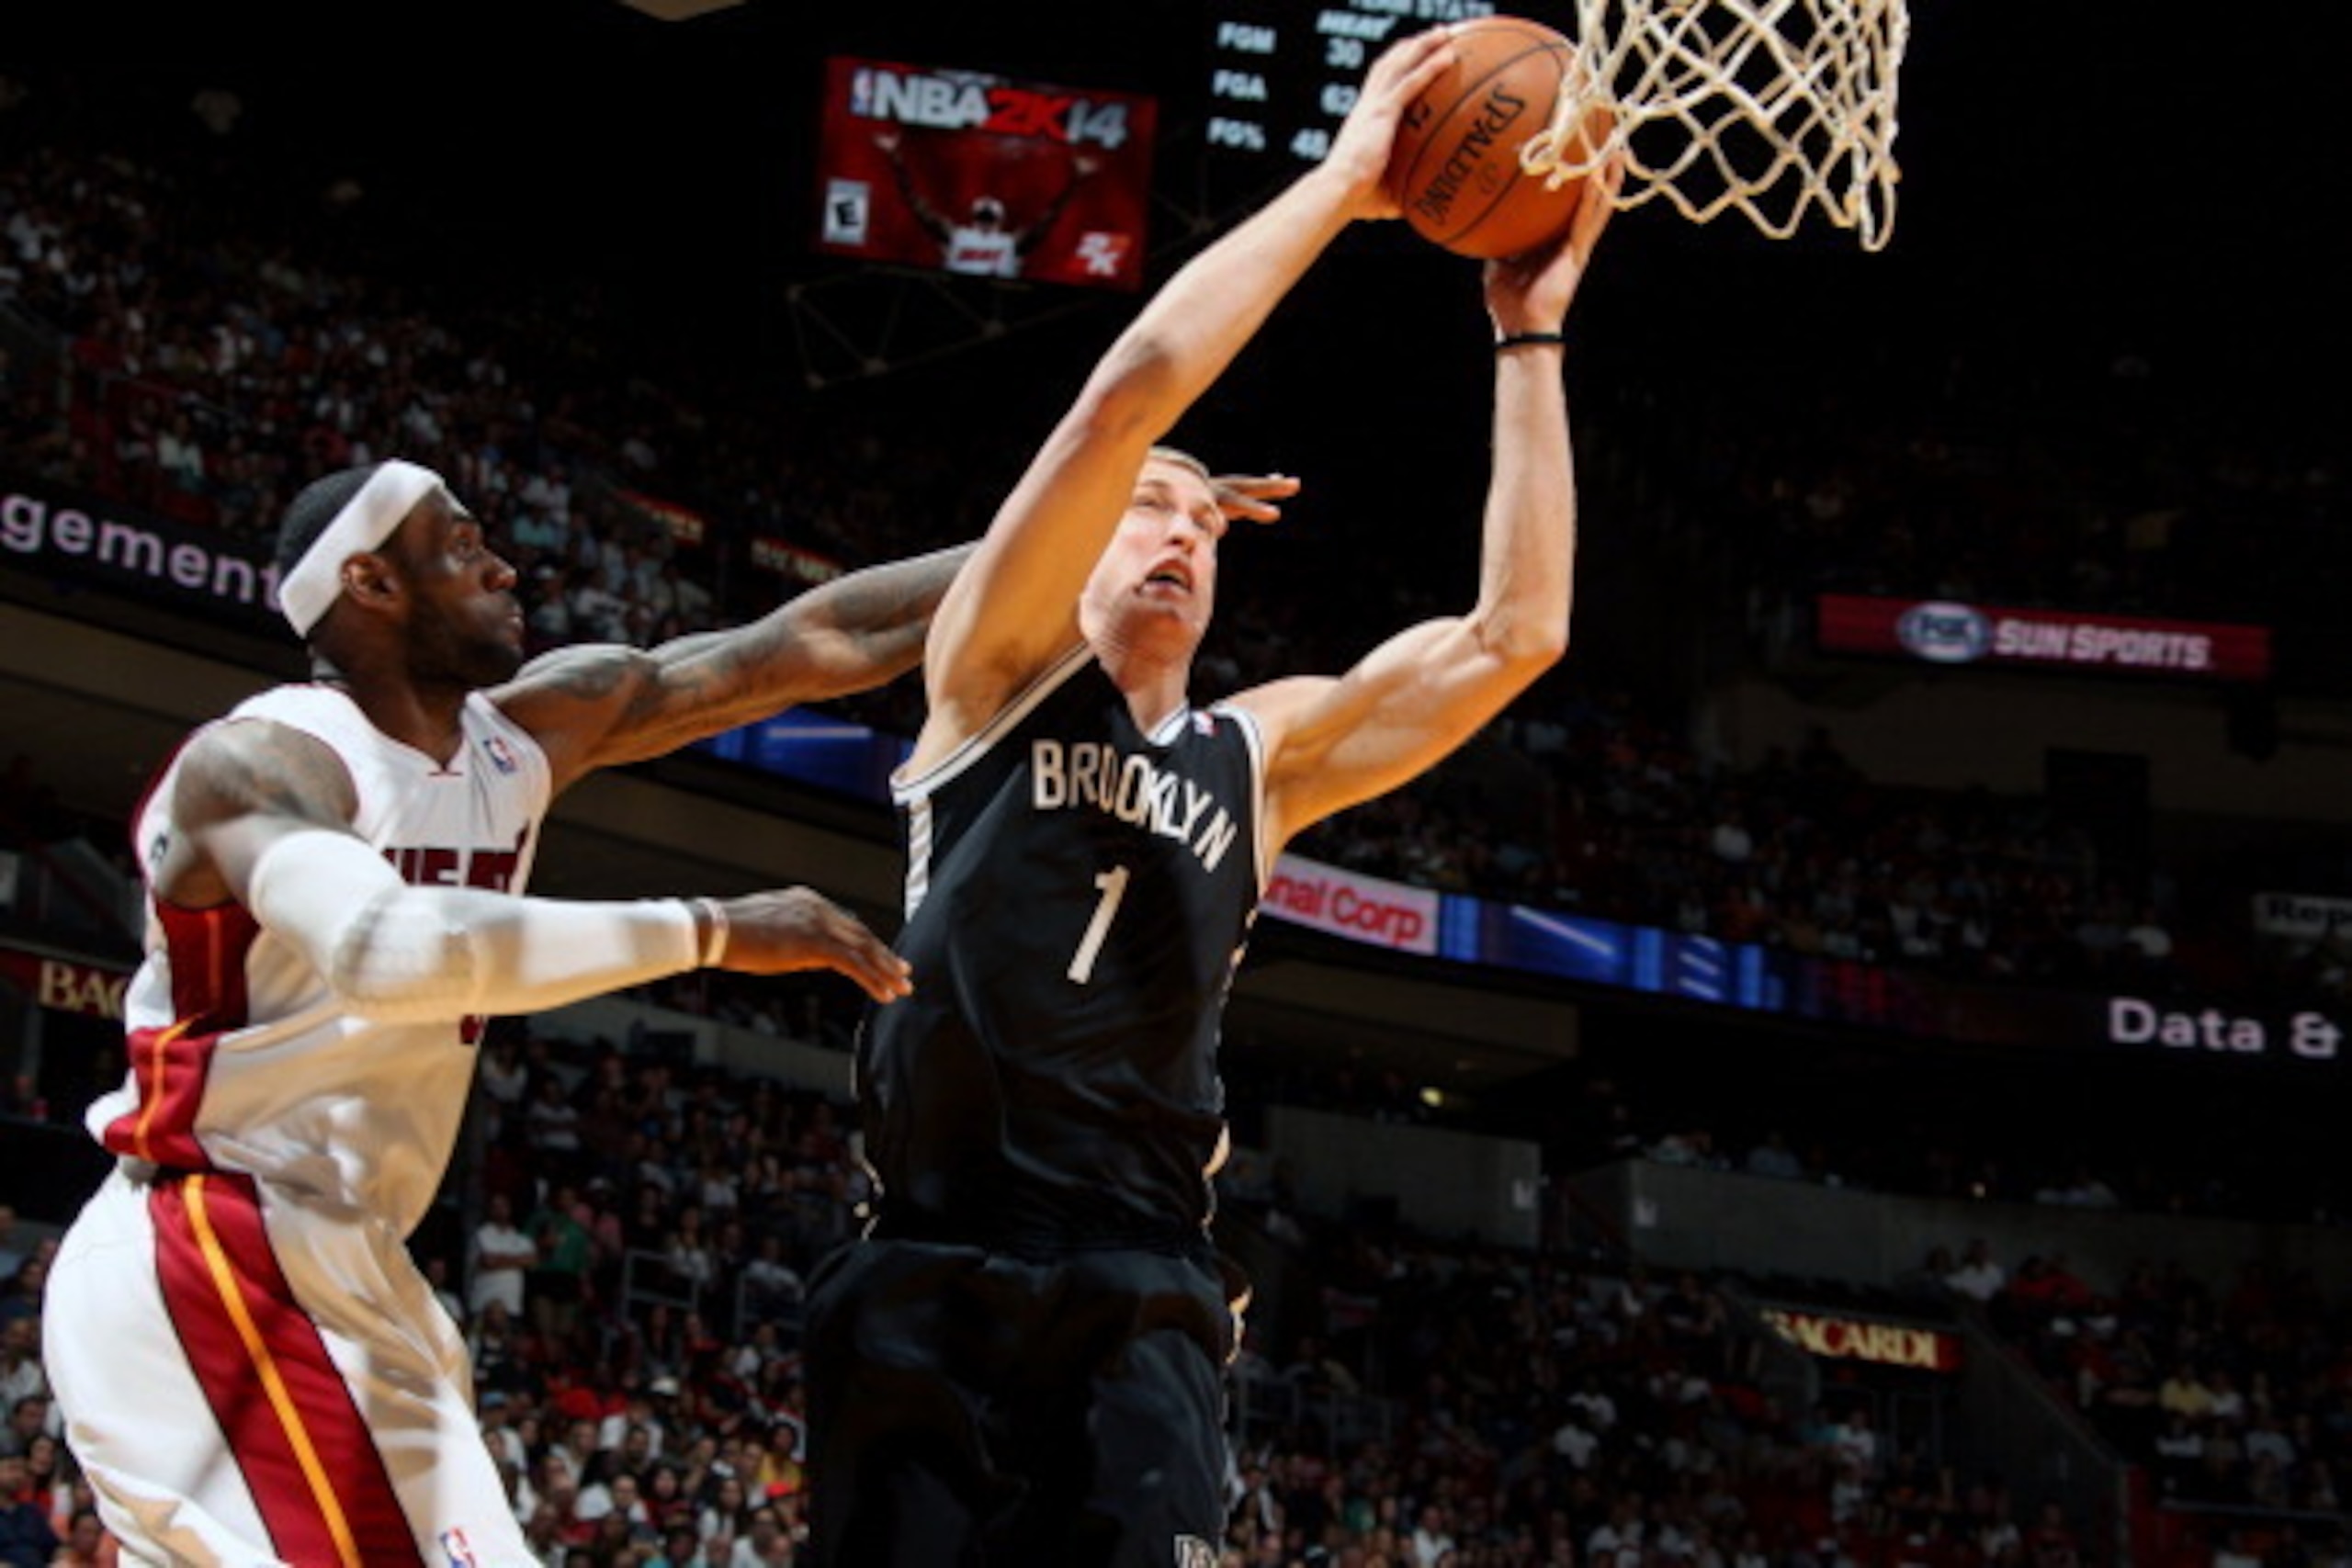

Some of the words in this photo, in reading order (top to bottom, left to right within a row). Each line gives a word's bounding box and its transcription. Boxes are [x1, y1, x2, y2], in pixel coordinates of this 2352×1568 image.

[1217, 20, 1278, 55] FGM
[1325, 37, 1366, 70] 30
[1212, 68, 1268, 102] FGA
[1206, 116, 1267, 152] FG%
[1414, 83, 1526, 228] SPALDING
[834, 197, 861, 230] E
[1993, 618, 2068, 659] SUN
[2069, 624, 2214, 672] SPORTS
[1031, 738, 1238, 874] BROOKLYN
[1066, 864, 1131, 986] 1
[1332, 886, 1422, 948] Corp
[2108, 995, 2267, 1053] Data
[2289, 1010, 2345, 1058] &
